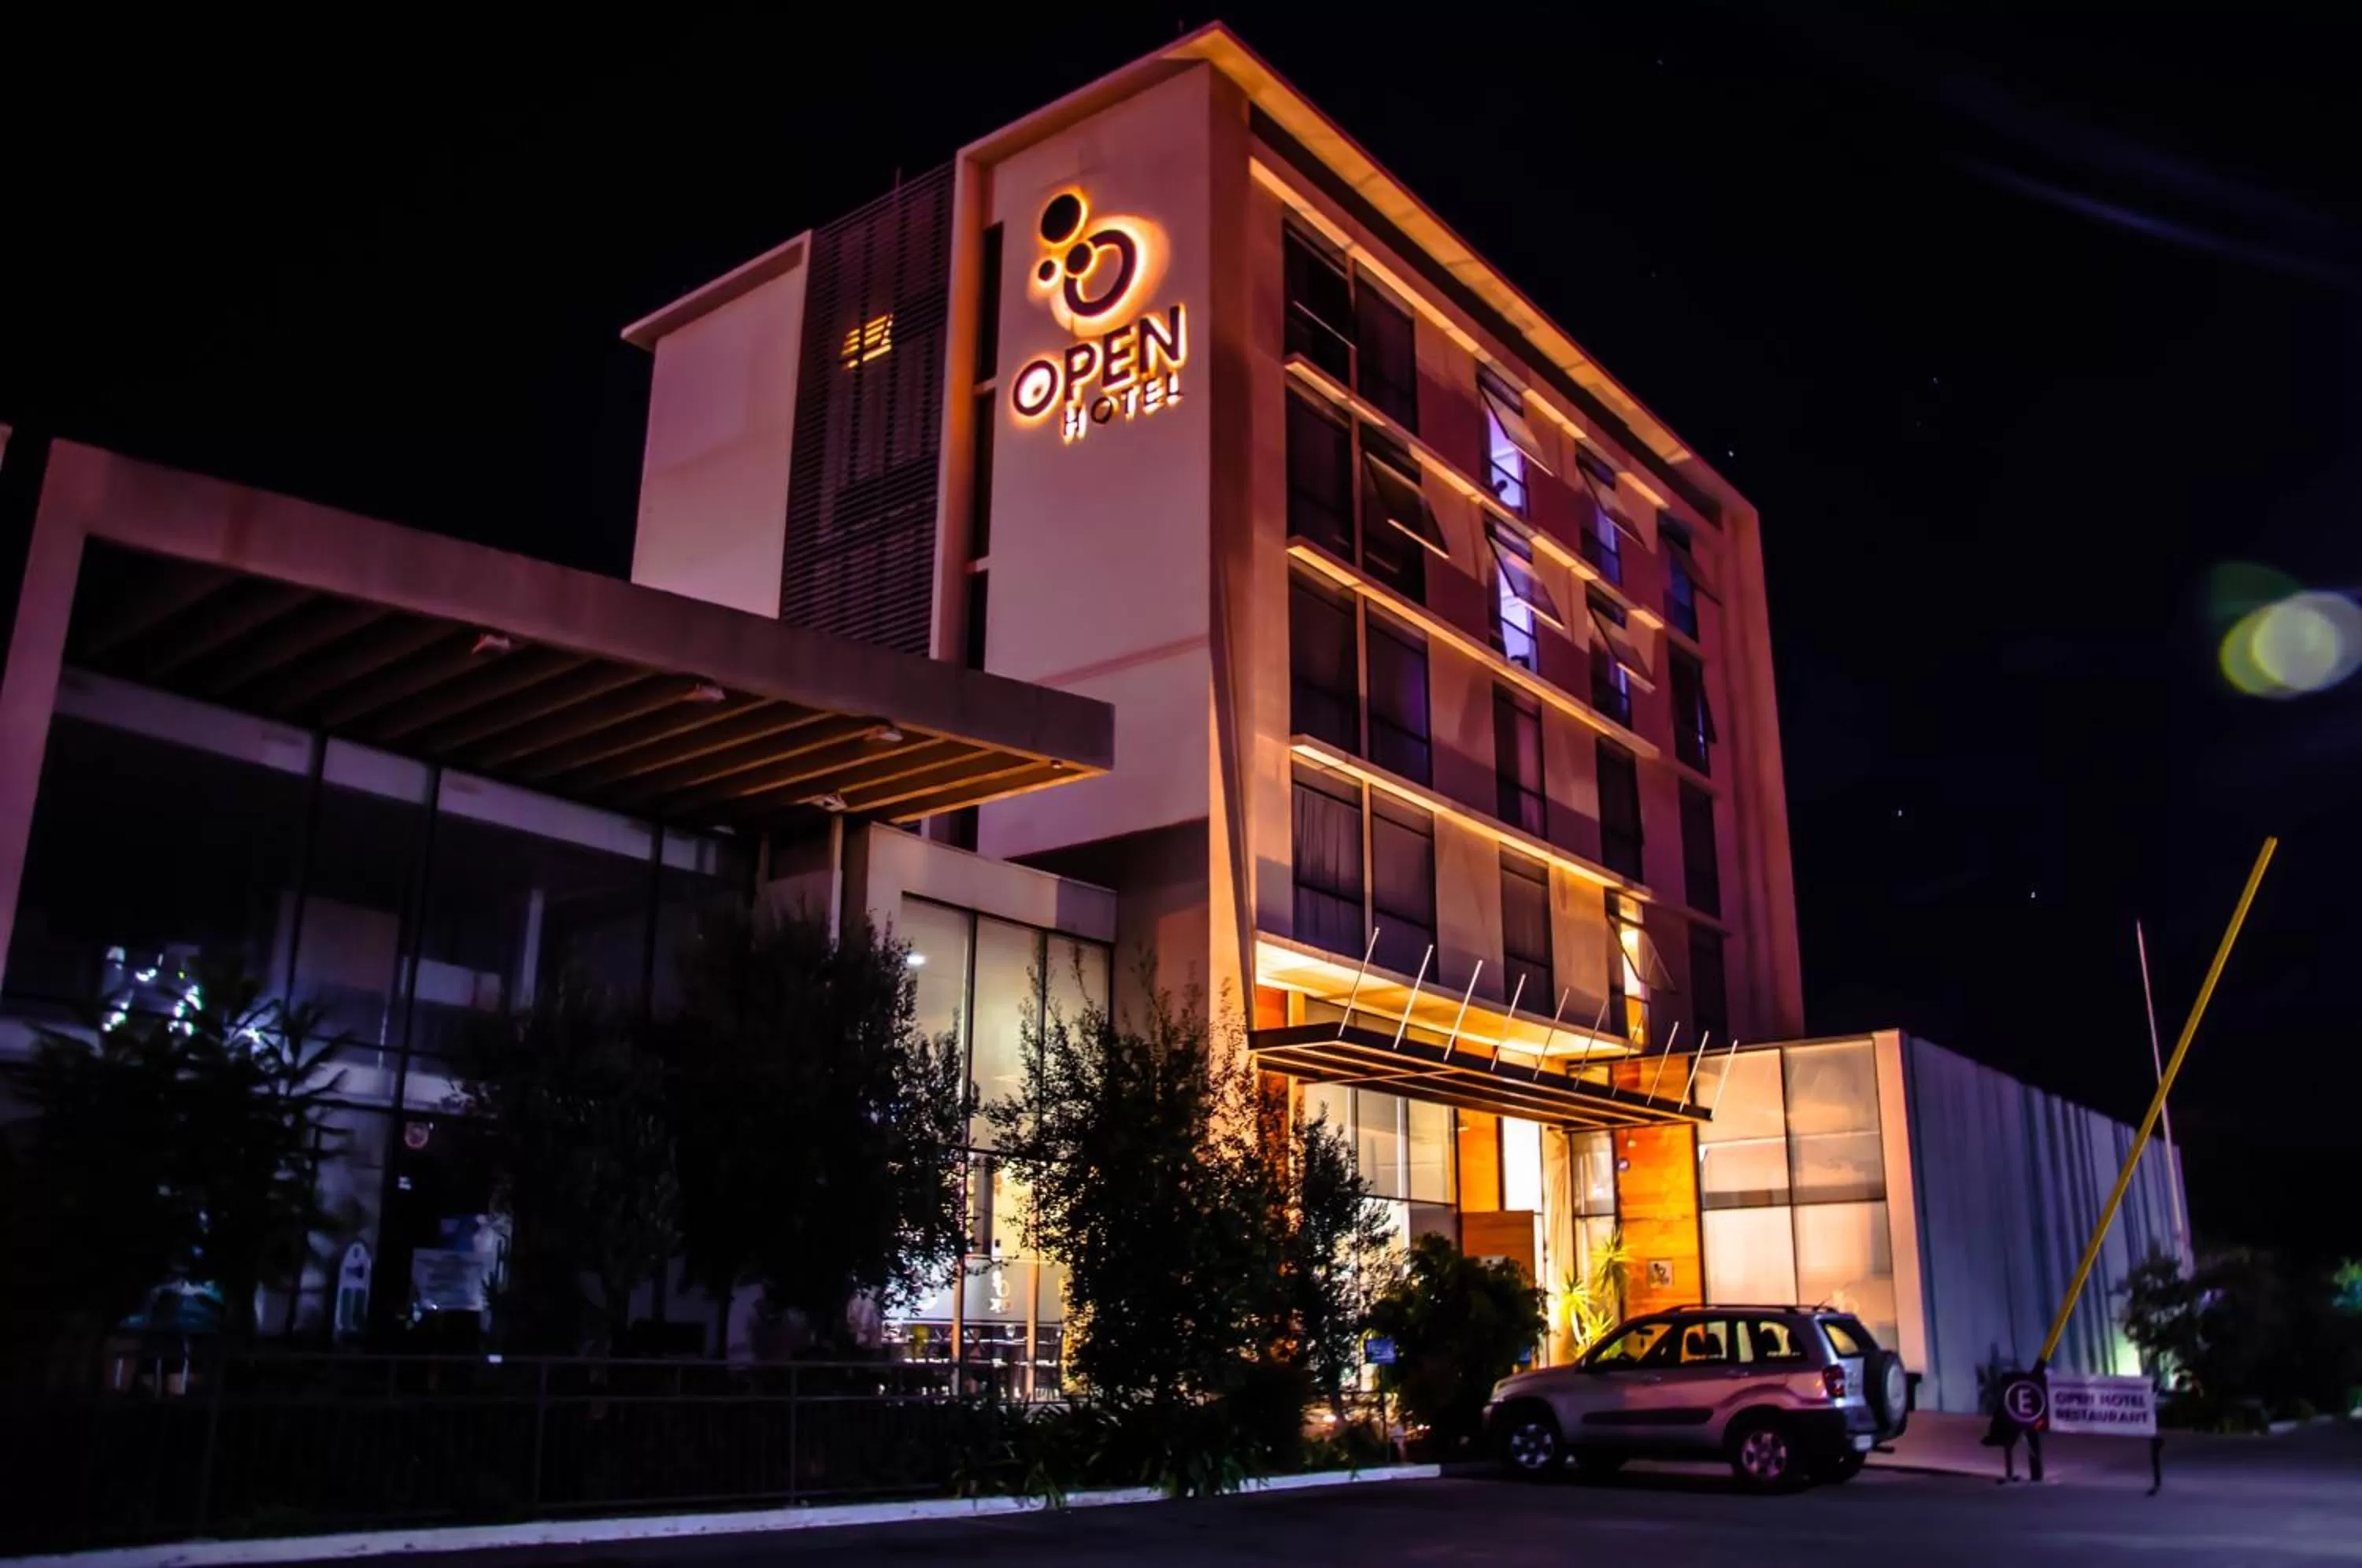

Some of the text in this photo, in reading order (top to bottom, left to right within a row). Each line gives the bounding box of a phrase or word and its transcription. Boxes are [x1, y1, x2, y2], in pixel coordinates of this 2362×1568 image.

[1013, 305, 1186, 416] OPEN
[1063, 373, 1184, 441] HOTEL
[2017, 1389, 2033, 1414] E
[2054, 1391, 2145, 1407] OPEN HOTEL
[2054, 1408, 2149, 1424] RESTAURANT
